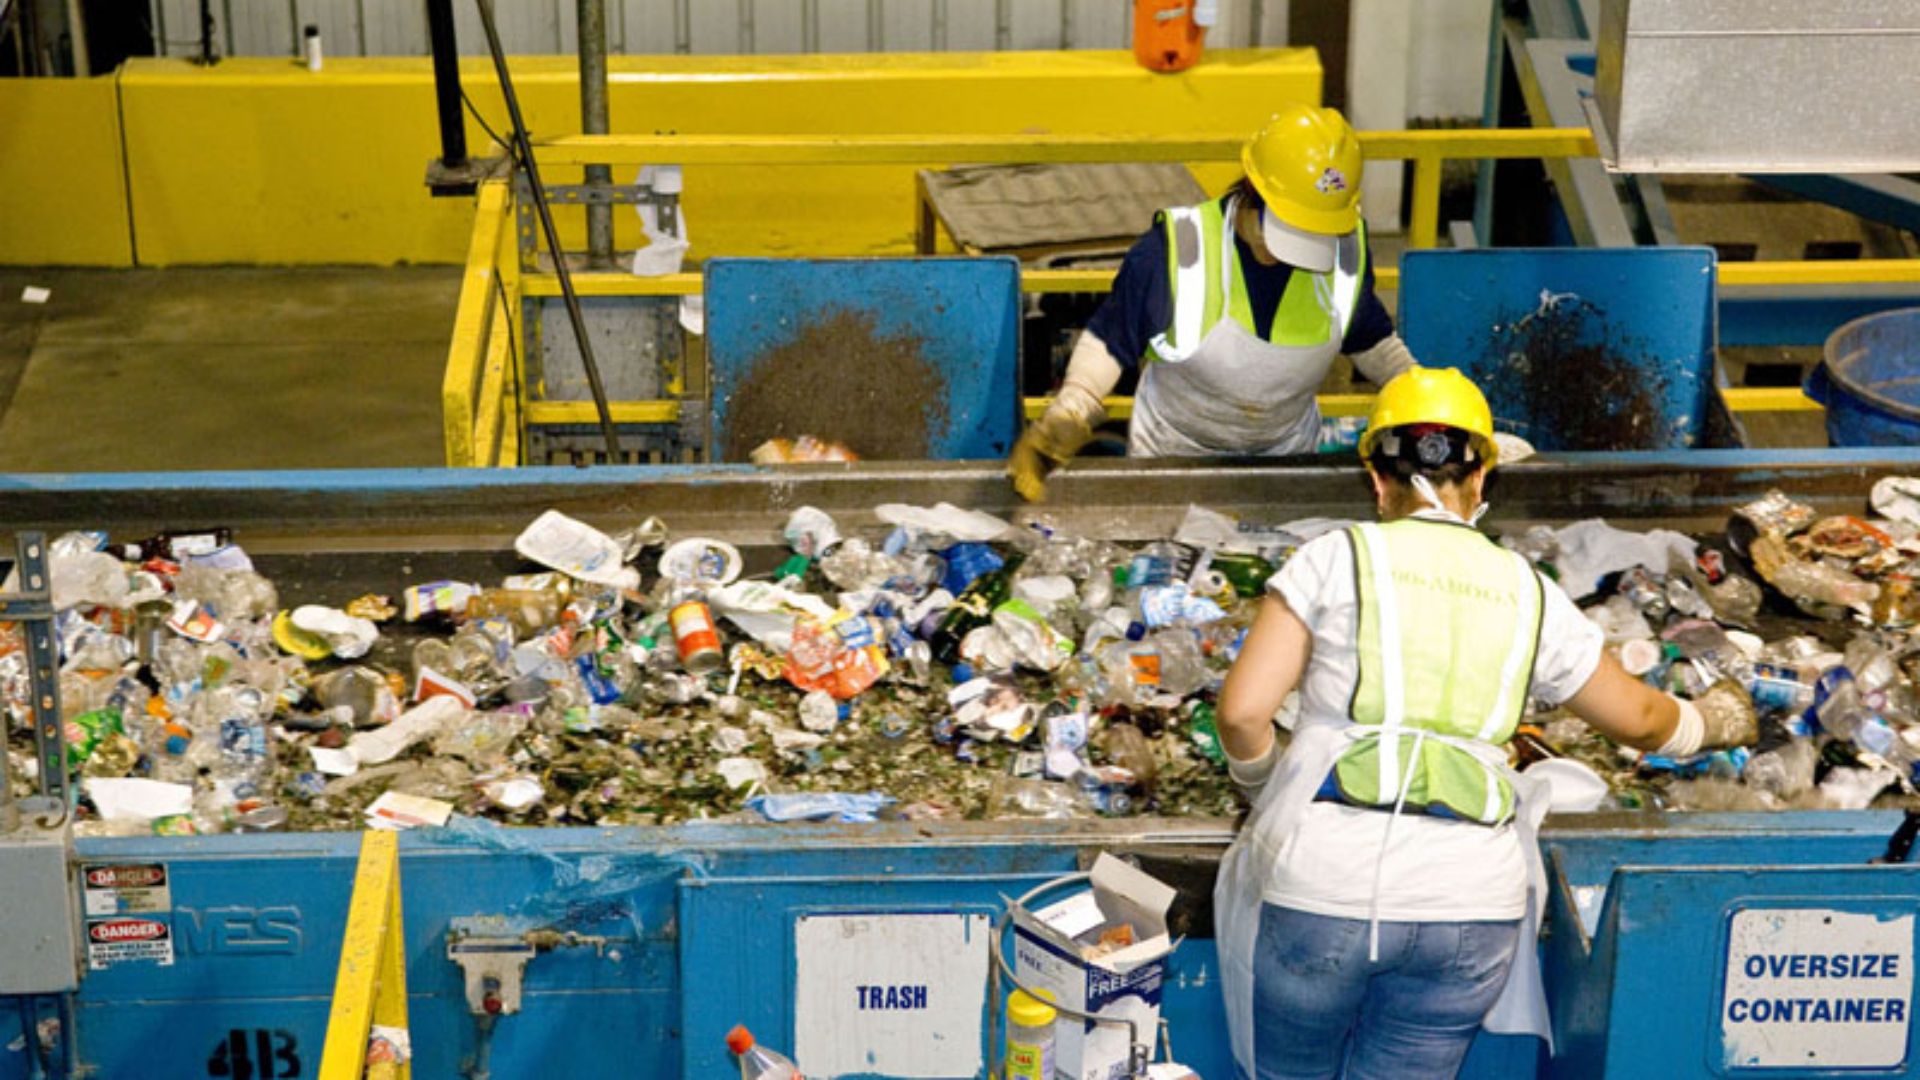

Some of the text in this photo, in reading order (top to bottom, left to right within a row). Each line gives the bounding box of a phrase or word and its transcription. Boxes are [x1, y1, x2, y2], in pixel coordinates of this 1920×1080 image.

[99, 924, 157, 938] DANGER
[1744, 954, 1900, 979] OVERSIZE
[856, 985, 928, 1010] TRASH
[1088, 975, 1129, 999] FREE
[1728, 998, 1906, 1023] CONTAINER
[207, 1028, 301, 1080] 4B
